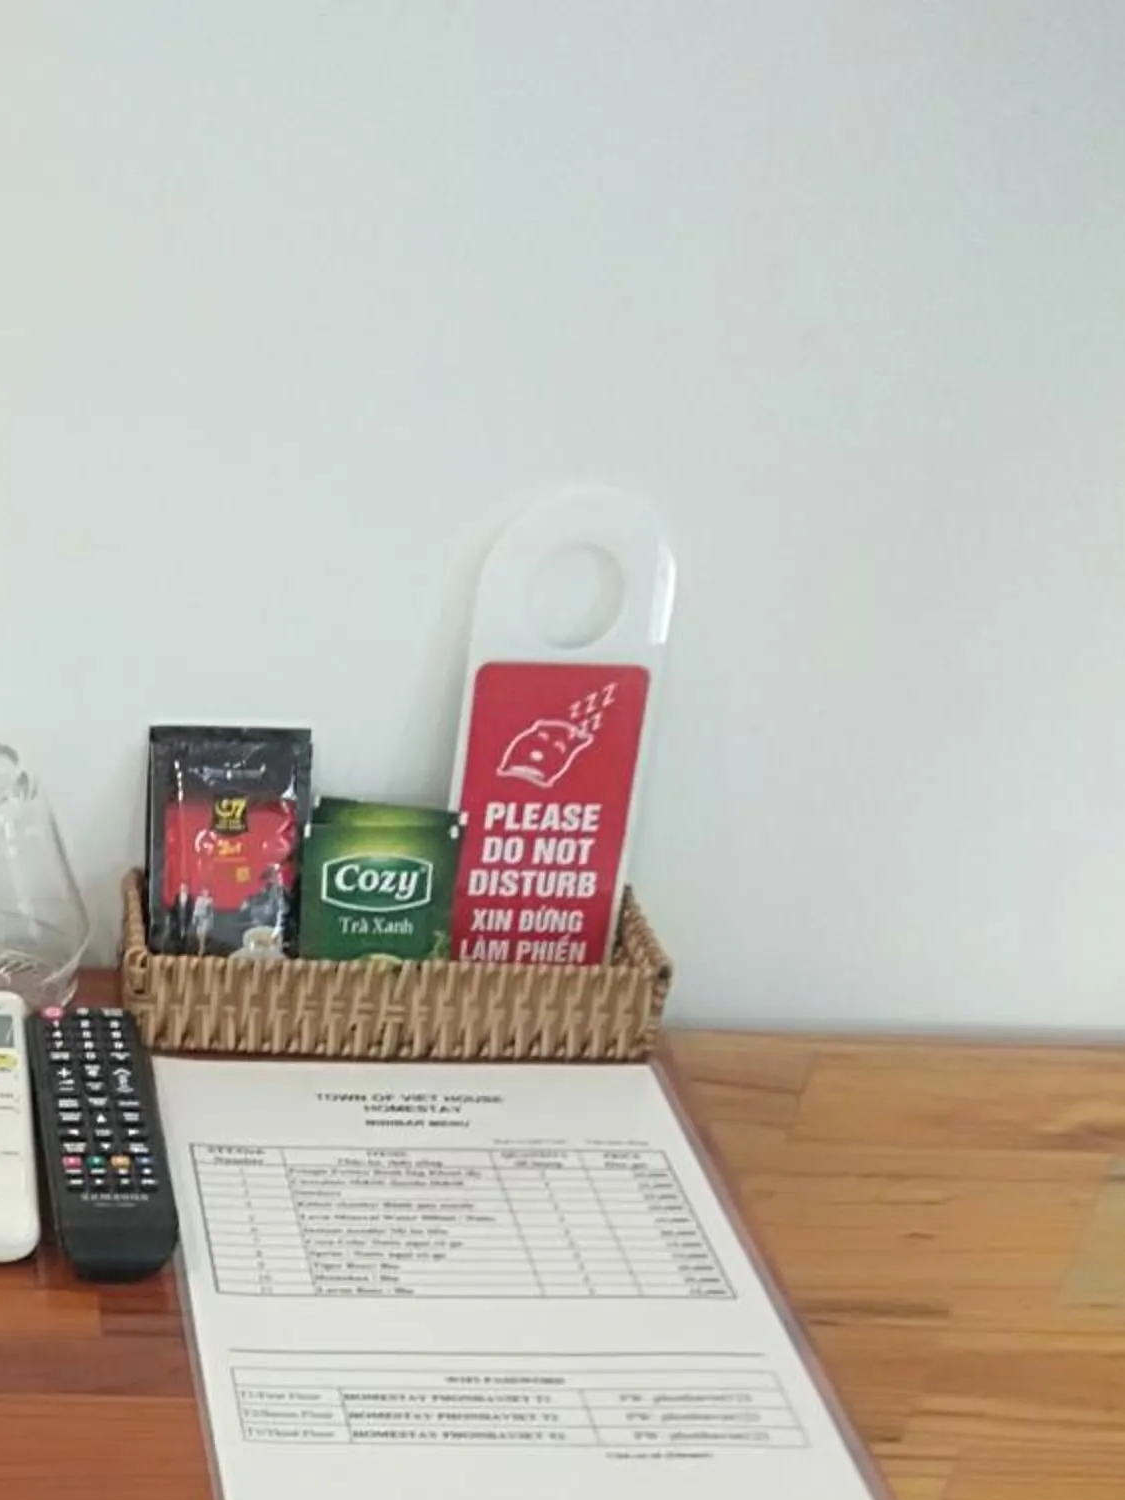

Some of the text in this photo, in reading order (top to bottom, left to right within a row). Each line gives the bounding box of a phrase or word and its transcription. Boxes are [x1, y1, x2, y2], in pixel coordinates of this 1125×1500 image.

[484, 802, 602, 832] PLEASE
[482, 837, 596, 864] DO NOT
[335, 864, 419, 900] Cozy
[467, 870, 598, 898] DISTURB
[373, 916, 414, 936] Xanh
[471, 908, 512, 932] XIN
